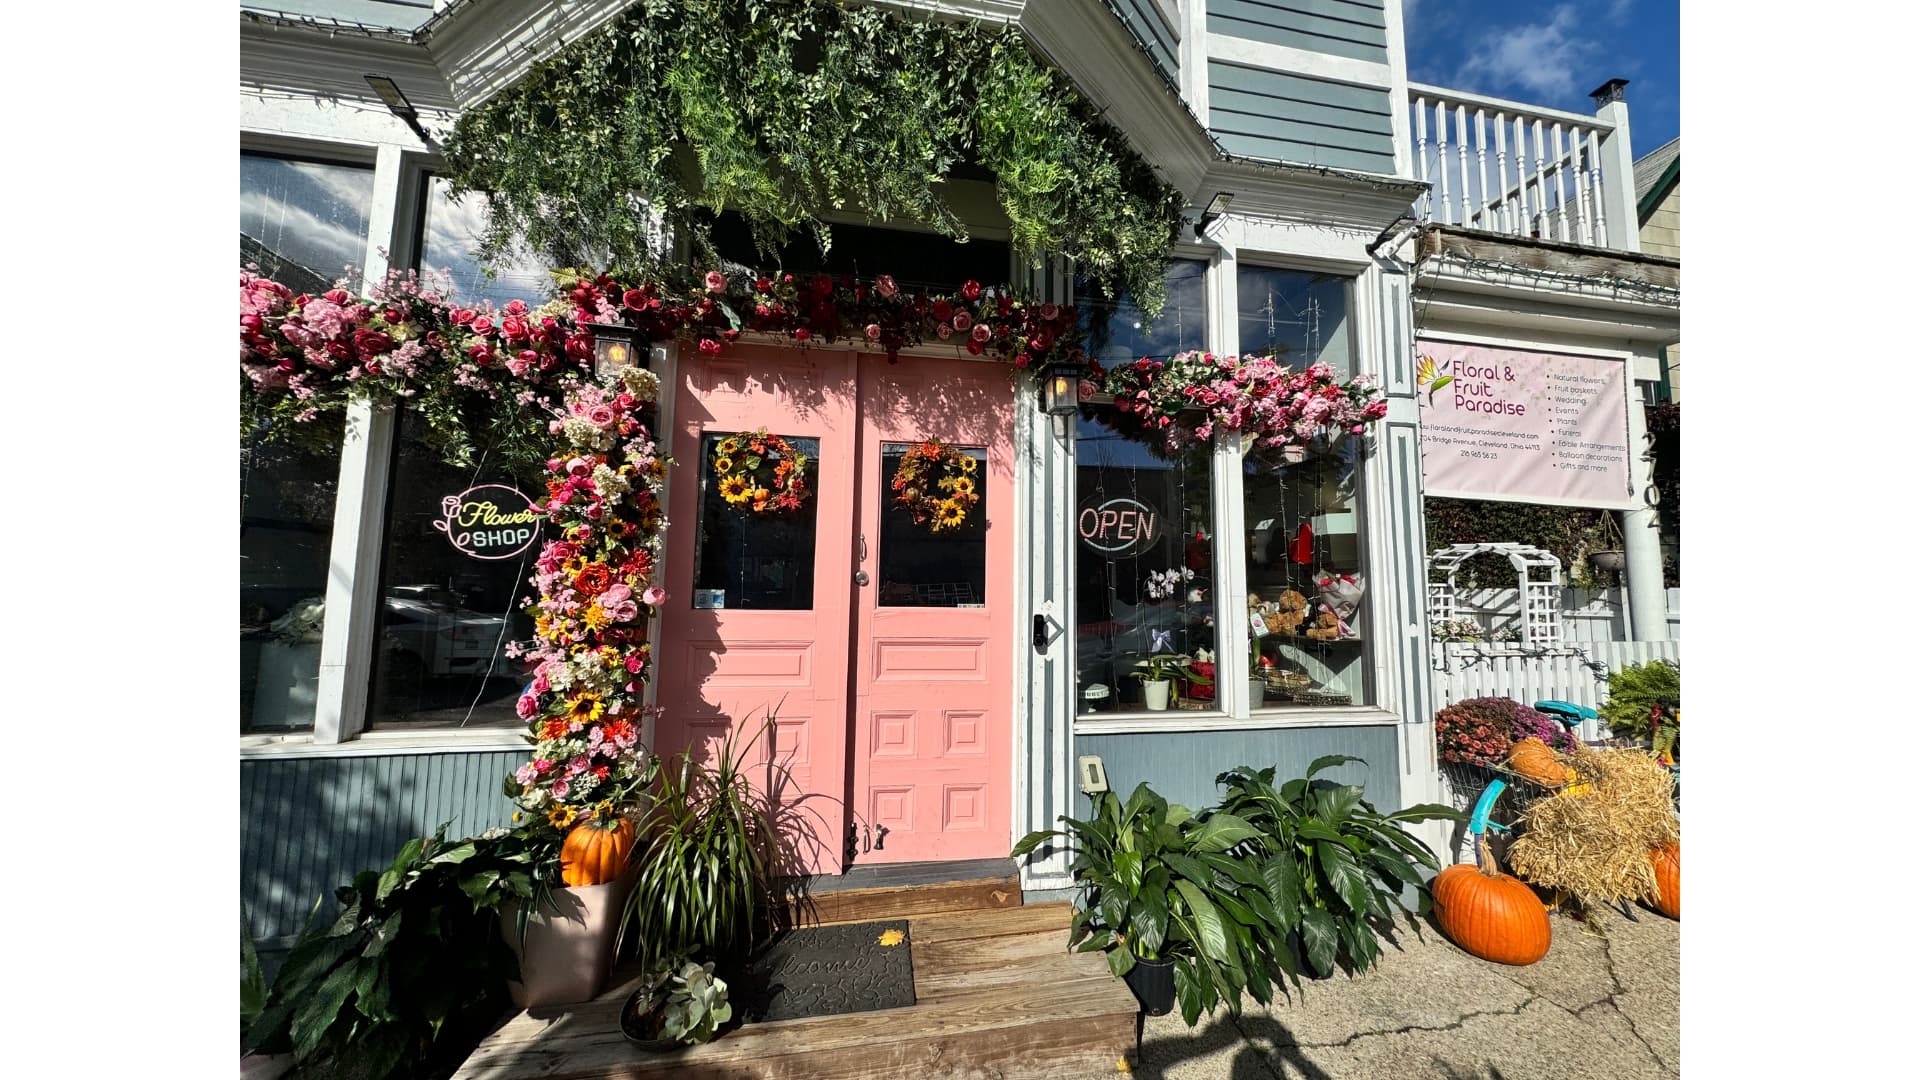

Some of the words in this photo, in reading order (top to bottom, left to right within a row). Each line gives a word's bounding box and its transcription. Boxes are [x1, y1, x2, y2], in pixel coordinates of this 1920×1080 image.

[1453, 360, 1500, 380] Floral
[1504, 366, 1516, 382] &
[1554, 374, 1579, 383] Natural
[1454, 379, 1493, 397] Fruit
[1455, 395, 1526, 416] Paradise
[1555, 396, 1586, 406] Wedding
[1555, 406, 1579, 415] Events
[1557, 418, 1577, 426] Plants
[1558, 429, 1582, 437] Funeral
[1432, 435, 1452, 445] Bridge
[1558, 440, 1578, 448] Edible
[1579, 442, 1626, 452] Arrangements
[1558, 451, 1585, 459] Balloon
[1585, 453, 1623, 462] decorations
[1559, 462, 1577, 470] Gifts
[458, 501, 536, 527] Flower
[1079, 508, 1155, 540] OPEN
[472, 528, 530, 547] SHOP
